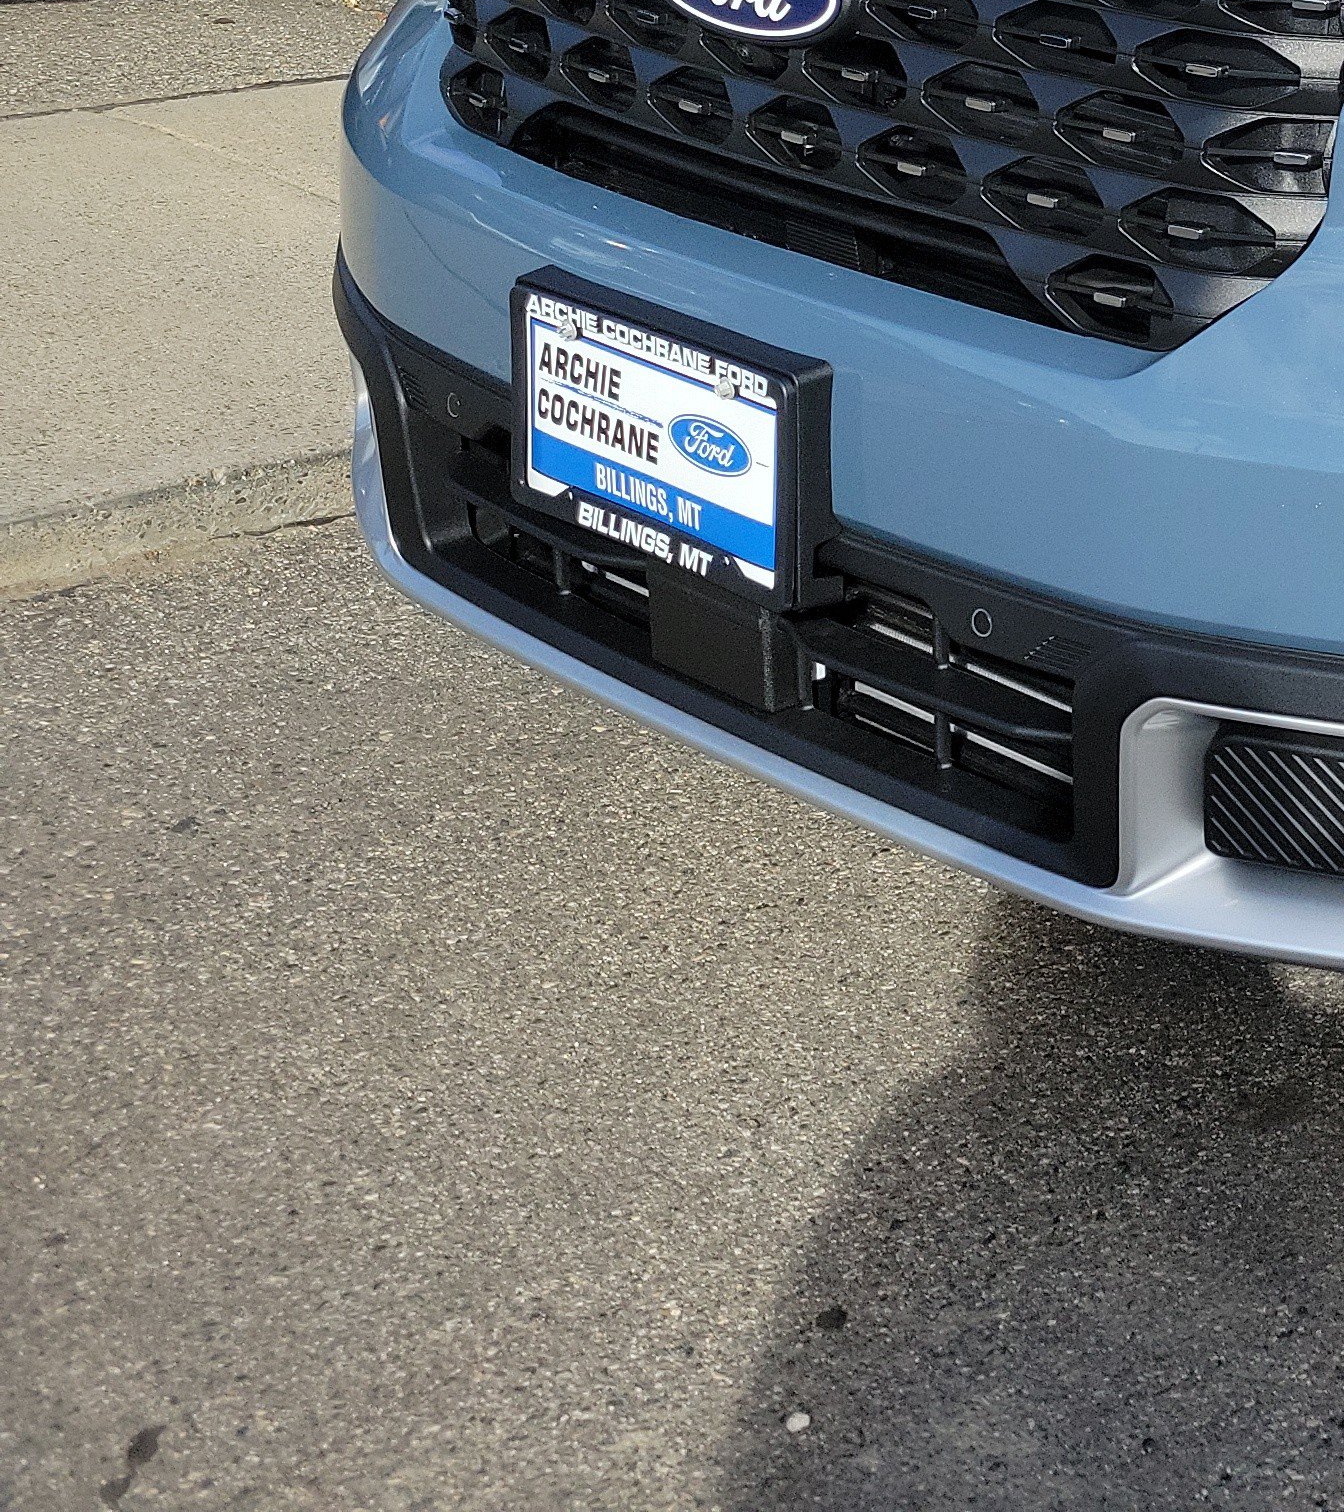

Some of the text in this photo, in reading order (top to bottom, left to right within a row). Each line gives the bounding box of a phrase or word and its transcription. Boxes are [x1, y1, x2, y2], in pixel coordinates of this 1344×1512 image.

[526, 294, 768, 397] ARCHIE COCHRANE FORD
[538, 342, 622, 402] ARCHIE
[538, 387, 660, 466] COCHRANE
[685, 420, 736, 468] Ford
[595, 463, 702, 531] BILLINGS, MT
[577, 501, 714, 577] BILLINGS, MT
